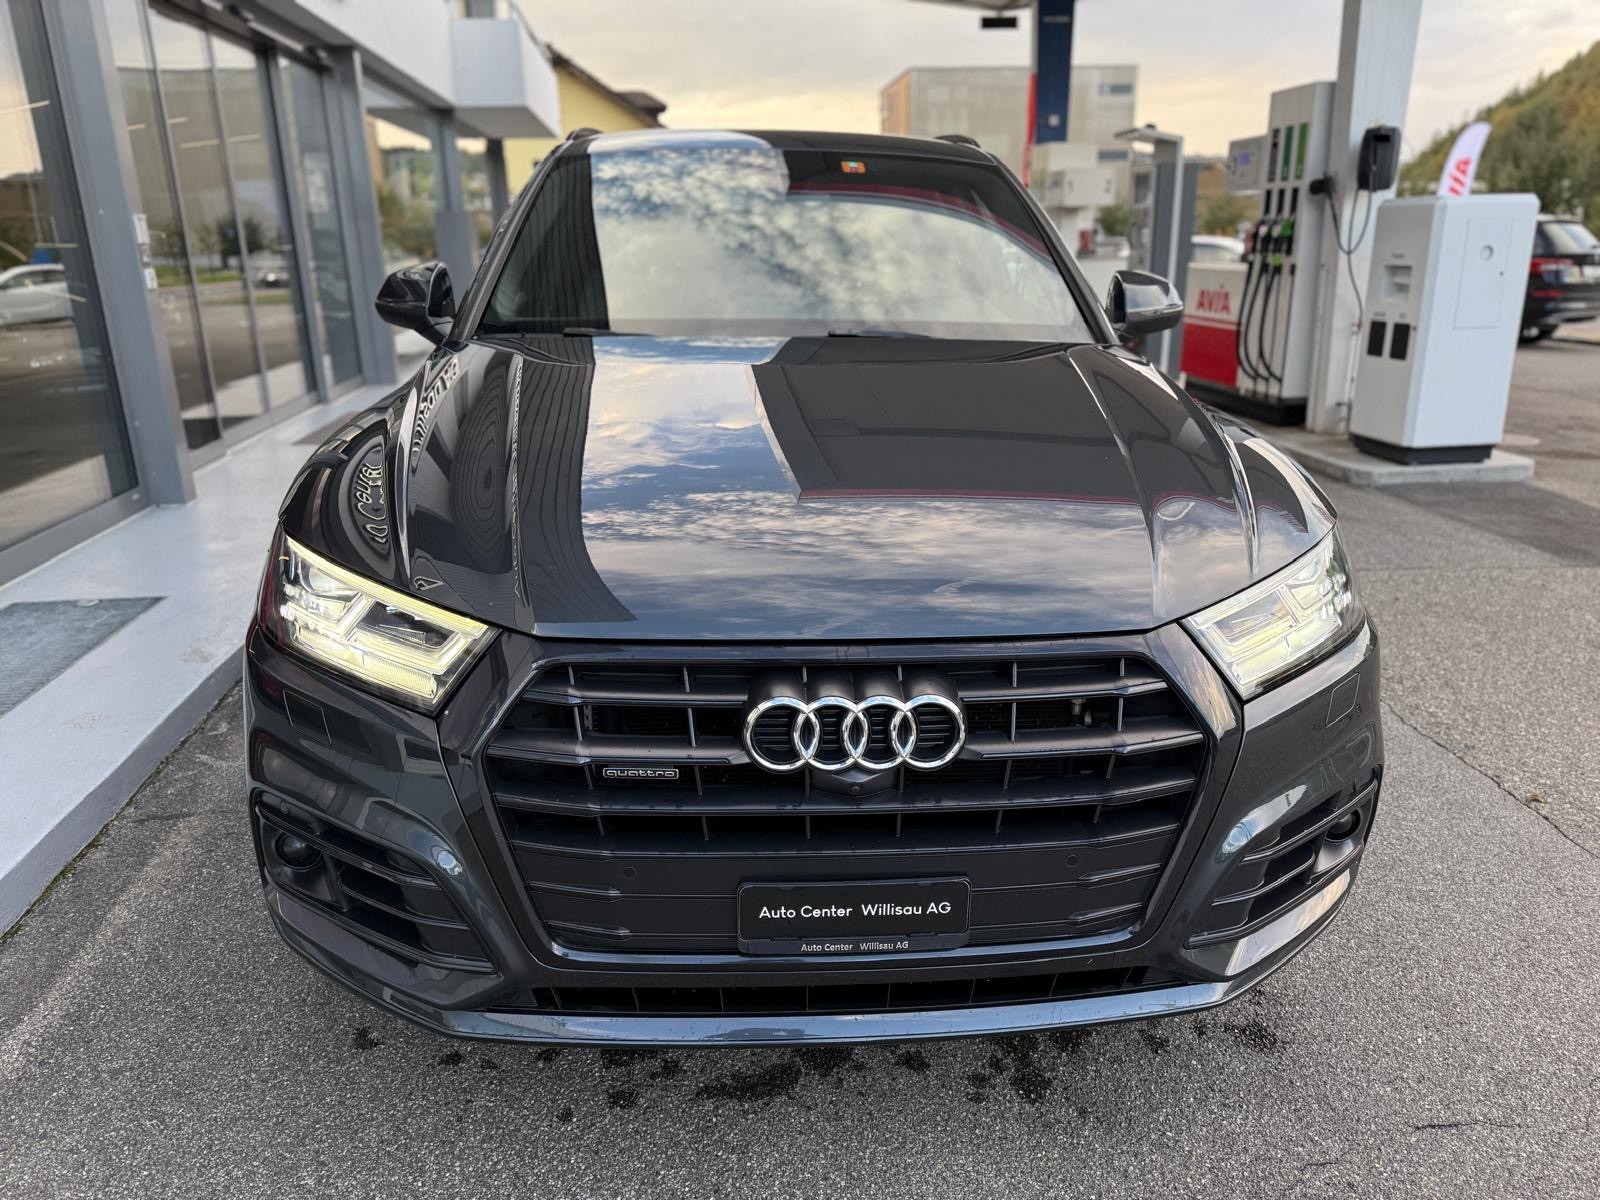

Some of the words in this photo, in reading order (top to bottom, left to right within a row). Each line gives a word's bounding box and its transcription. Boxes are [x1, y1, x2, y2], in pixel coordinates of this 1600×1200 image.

[1196, 289, 1231, 314] AVIA
[606, 769, 675, 777] quattro
[759, 905, 796, 919] Auto
[800, 904, 853, 918] Center
[861, 903, 922, 916] Willisau
[926, 901, 952, 914] AG
[801, 943, 822, 952] Auto
[824, 942, 853, 951] Center
[860, 941, 893, 951] Willisau
[895, 940, 909, 949] AG
